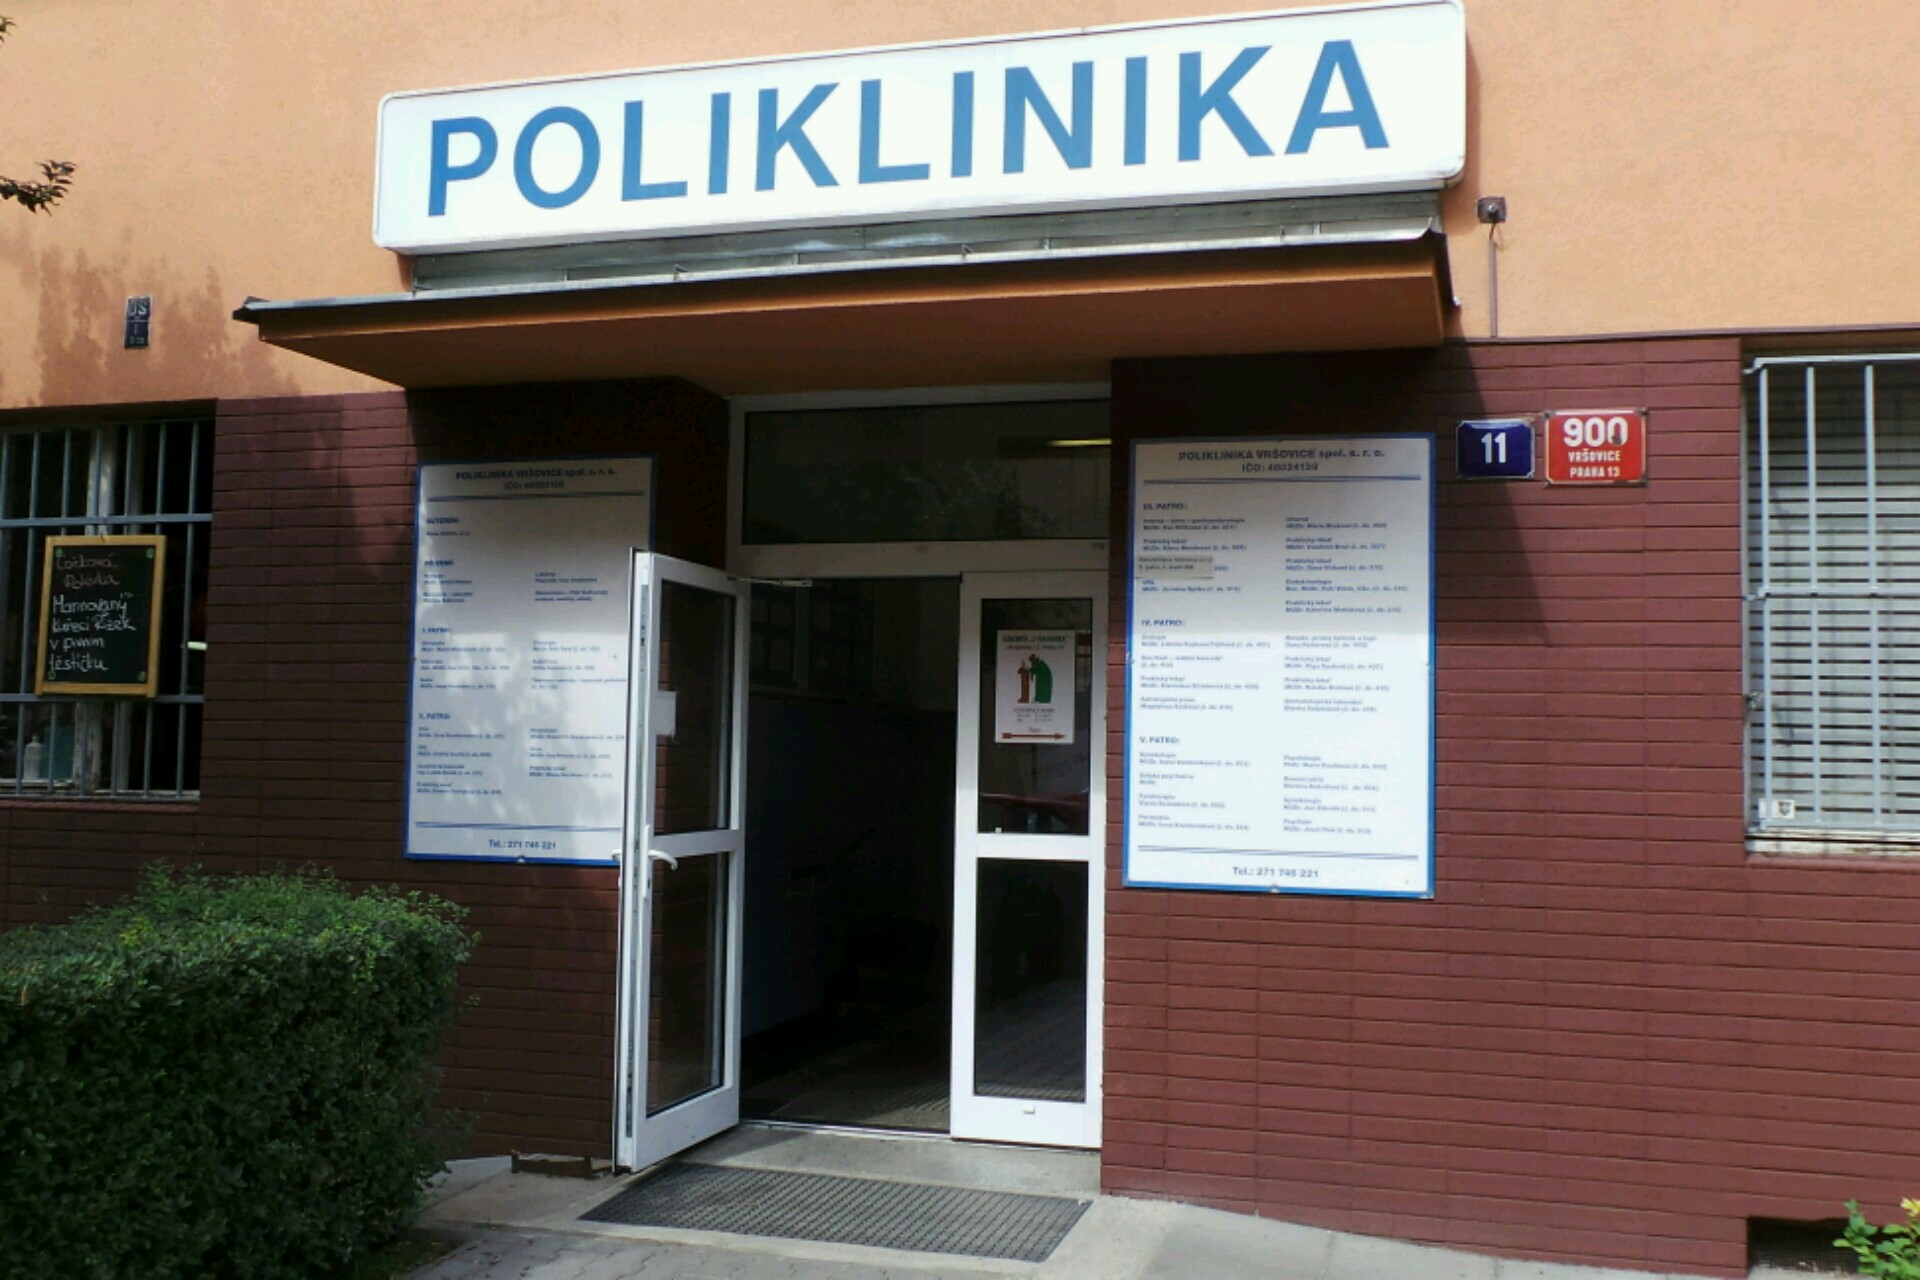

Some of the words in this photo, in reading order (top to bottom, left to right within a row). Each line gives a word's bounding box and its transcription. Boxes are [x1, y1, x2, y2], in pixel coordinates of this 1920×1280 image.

[427, 38, 1391, 217] POLIKLINIKA
[1563, 416, 1629, 447] 900
[1178, 451, 1254, 461] POLIKLINIKA
[1255, 448, 1316, 460] VRŠOVICE
[1480, 432, 1507, 464] 11
[1567, 448, 1622, 463] VRŠOVICE
[1569, 466, 1605, 478] PRAHA
[1607, 465, 1621, 478] 13
[488, 839, 506, 849] Tel.:
[1232, 866, 1255, 876] Tel.:
